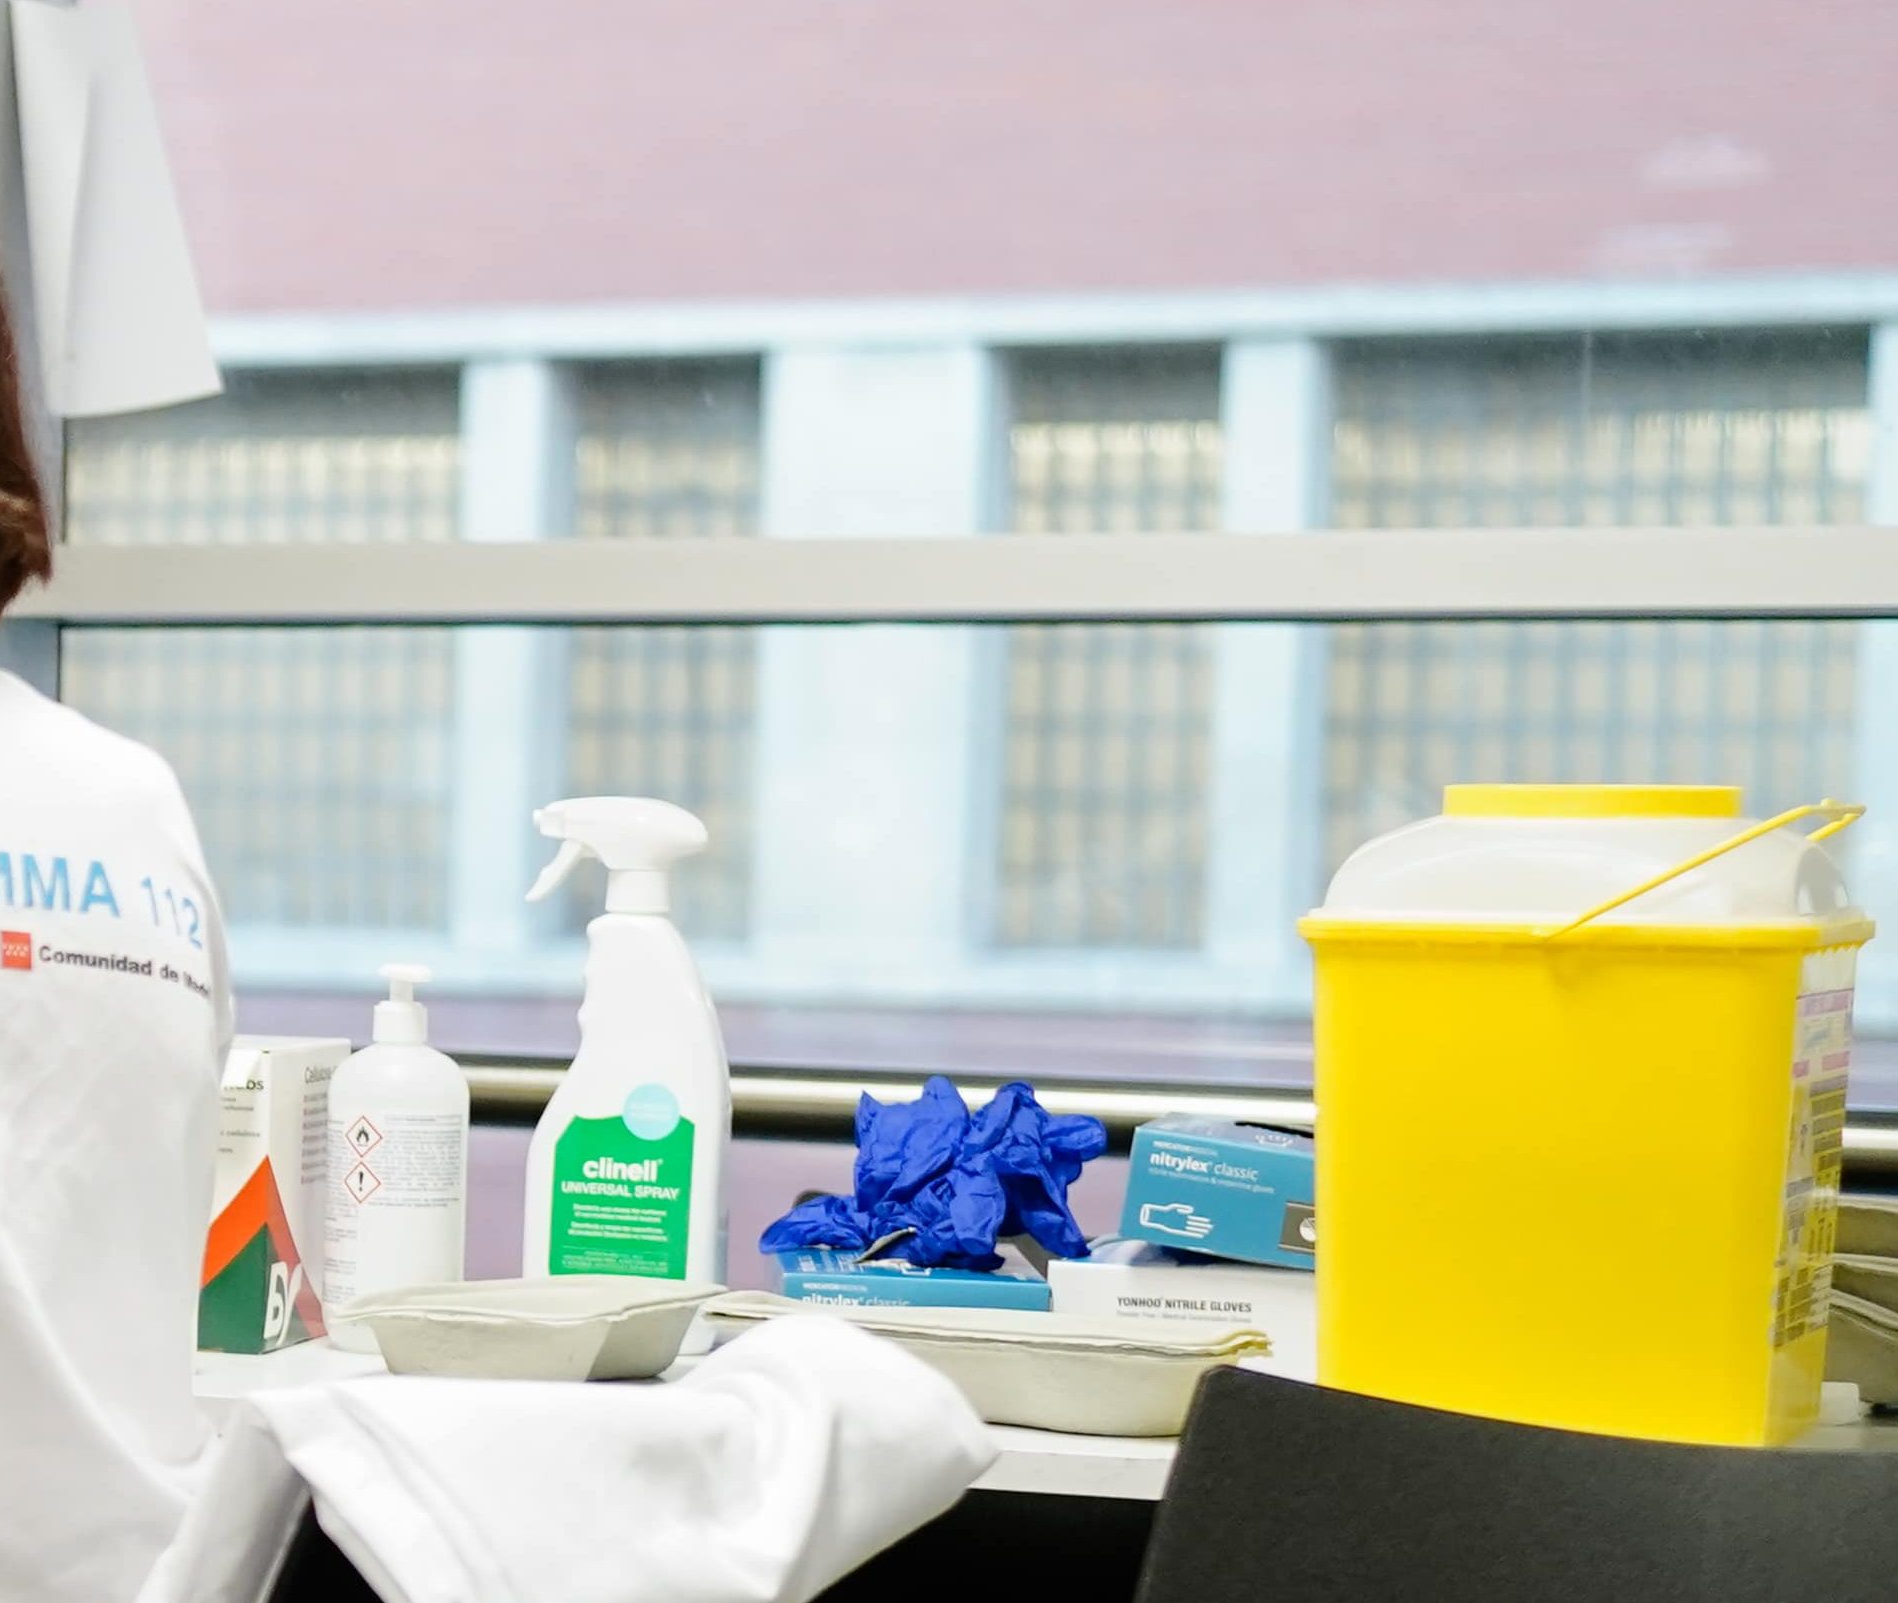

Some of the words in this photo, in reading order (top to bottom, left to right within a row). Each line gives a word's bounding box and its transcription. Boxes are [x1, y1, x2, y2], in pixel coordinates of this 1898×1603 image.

[140, 875, 203, 950] 112
[38, 945, 153, 977] Comunidad
[160, 964, 179, 984] de
[582, 1157, 659, 1182] clinell
[1149, 1151, 1209, 1173] nitrylex
[1214, 1163, 1259, 1181] classic
[561, 1181, 633, 1198] UNIVERSAL
[635, 1184, 681, 1200] SPRAY
[1165, 1299, 1206, 1311] NITRILE
[1210, 1301, 1252, 1313] GLOVES
